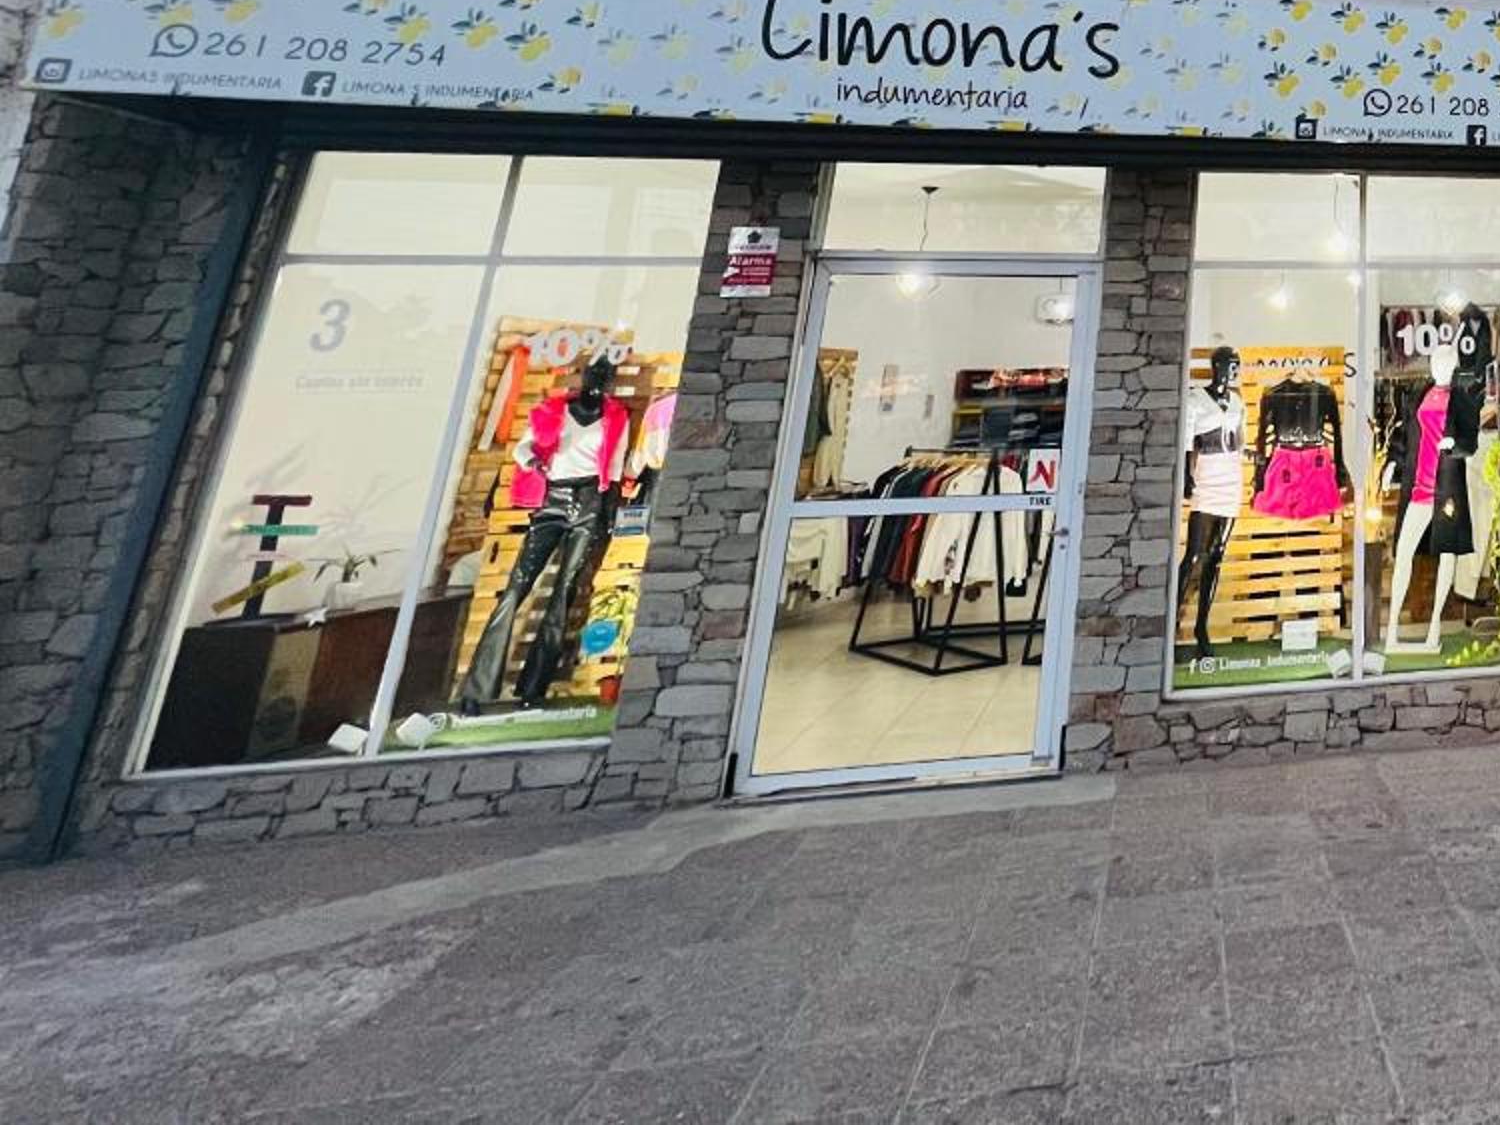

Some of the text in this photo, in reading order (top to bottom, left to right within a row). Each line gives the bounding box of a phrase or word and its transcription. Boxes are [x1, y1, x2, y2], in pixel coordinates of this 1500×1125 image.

[203, 32, 446, 67] 261 208 2754
[837, 77, 1028, 112] indumentaria
[1396, 94, 1436, 115] 261
[1449, 96, 1490, 117] 208
[309, 299, 351, 353] 3
[1397, 321, 1476, 356] 10%
